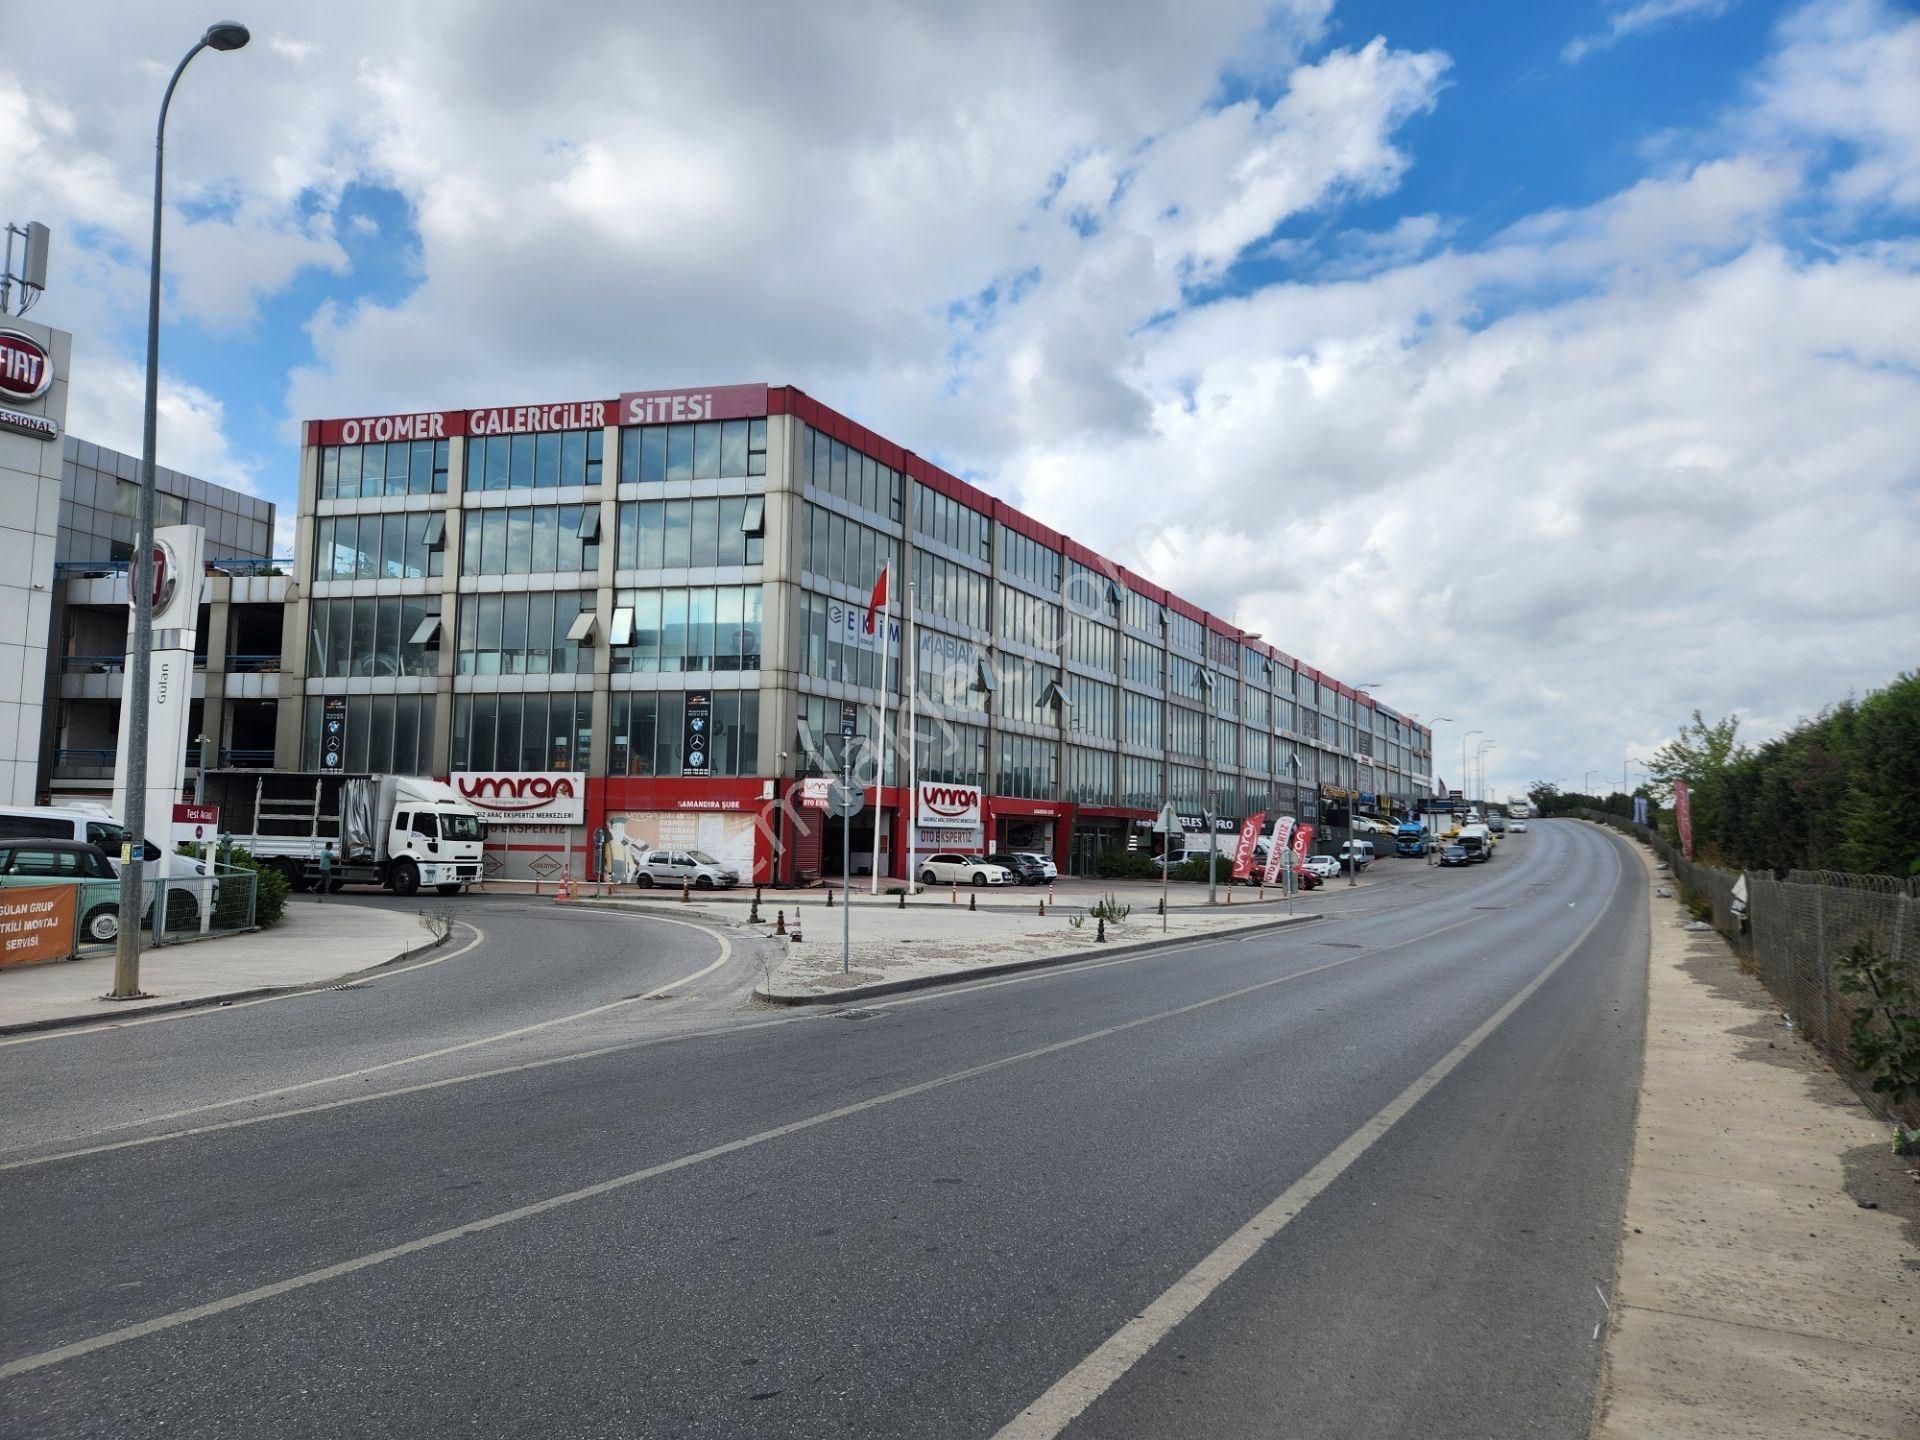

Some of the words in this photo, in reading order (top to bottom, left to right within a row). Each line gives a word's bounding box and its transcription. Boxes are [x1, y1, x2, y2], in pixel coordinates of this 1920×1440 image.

[0, 346, 41, 385] FIAT
[342, 413, 445, 444] OTOMER
[187, 809, 199, 819] Test
[921, 831, 935, 843] OTO
[30, 901, 54, 913] GRUP
[24, 917, 58, 930] MONTAJ
